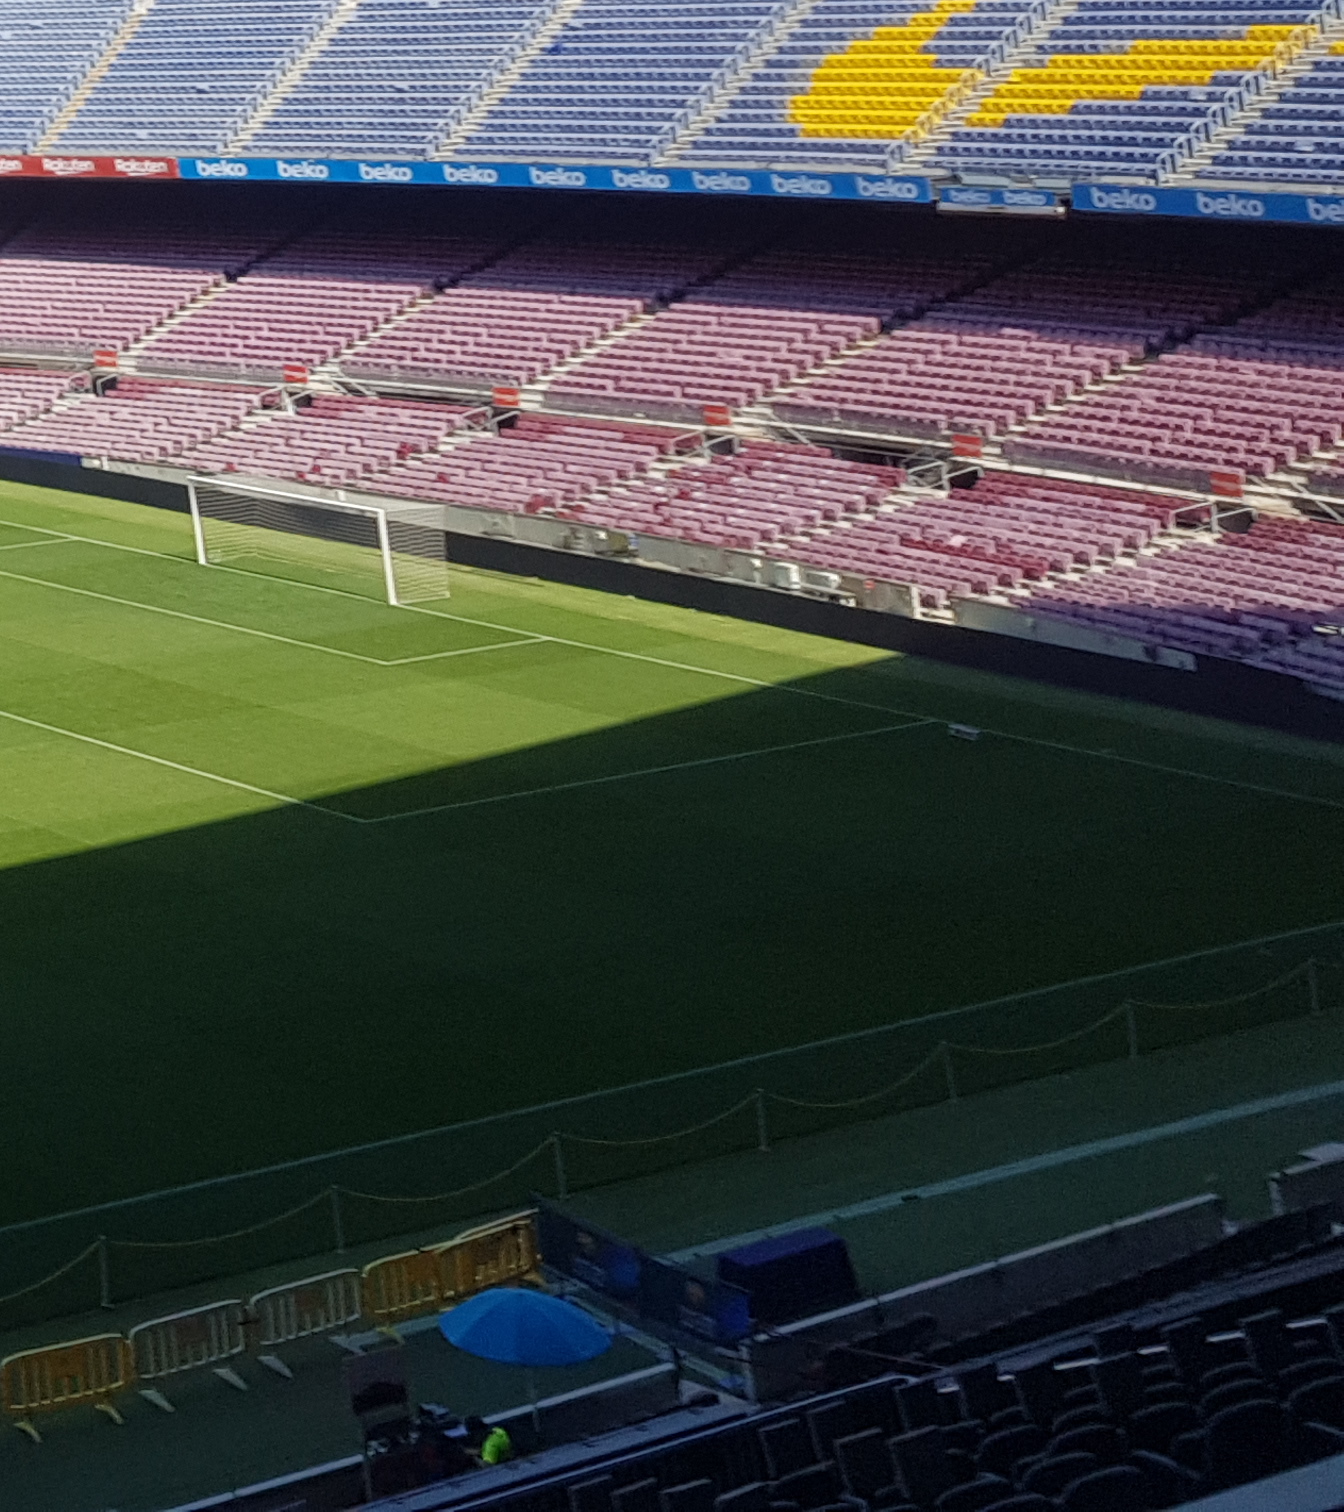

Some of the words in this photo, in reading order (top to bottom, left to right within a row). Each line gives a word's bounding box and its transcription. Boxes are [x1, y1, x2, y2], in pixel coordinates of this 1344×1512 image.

[196, 159, 248, 178] beko
[277, 160, 330, 178] beko
[358, 163, 413, 181] beko
[443, 164, 499, 183] beko
[529, 166, 586, 186] beko
[612, 169, 670, 189] beko
[692, 171, 751, 191] beko
[772, 174, 832, 195] beko
[855, 177, 919, 199] beko
[1090, 187, 1156, 211] beko
[1197, 192, 1265, 216] beko
